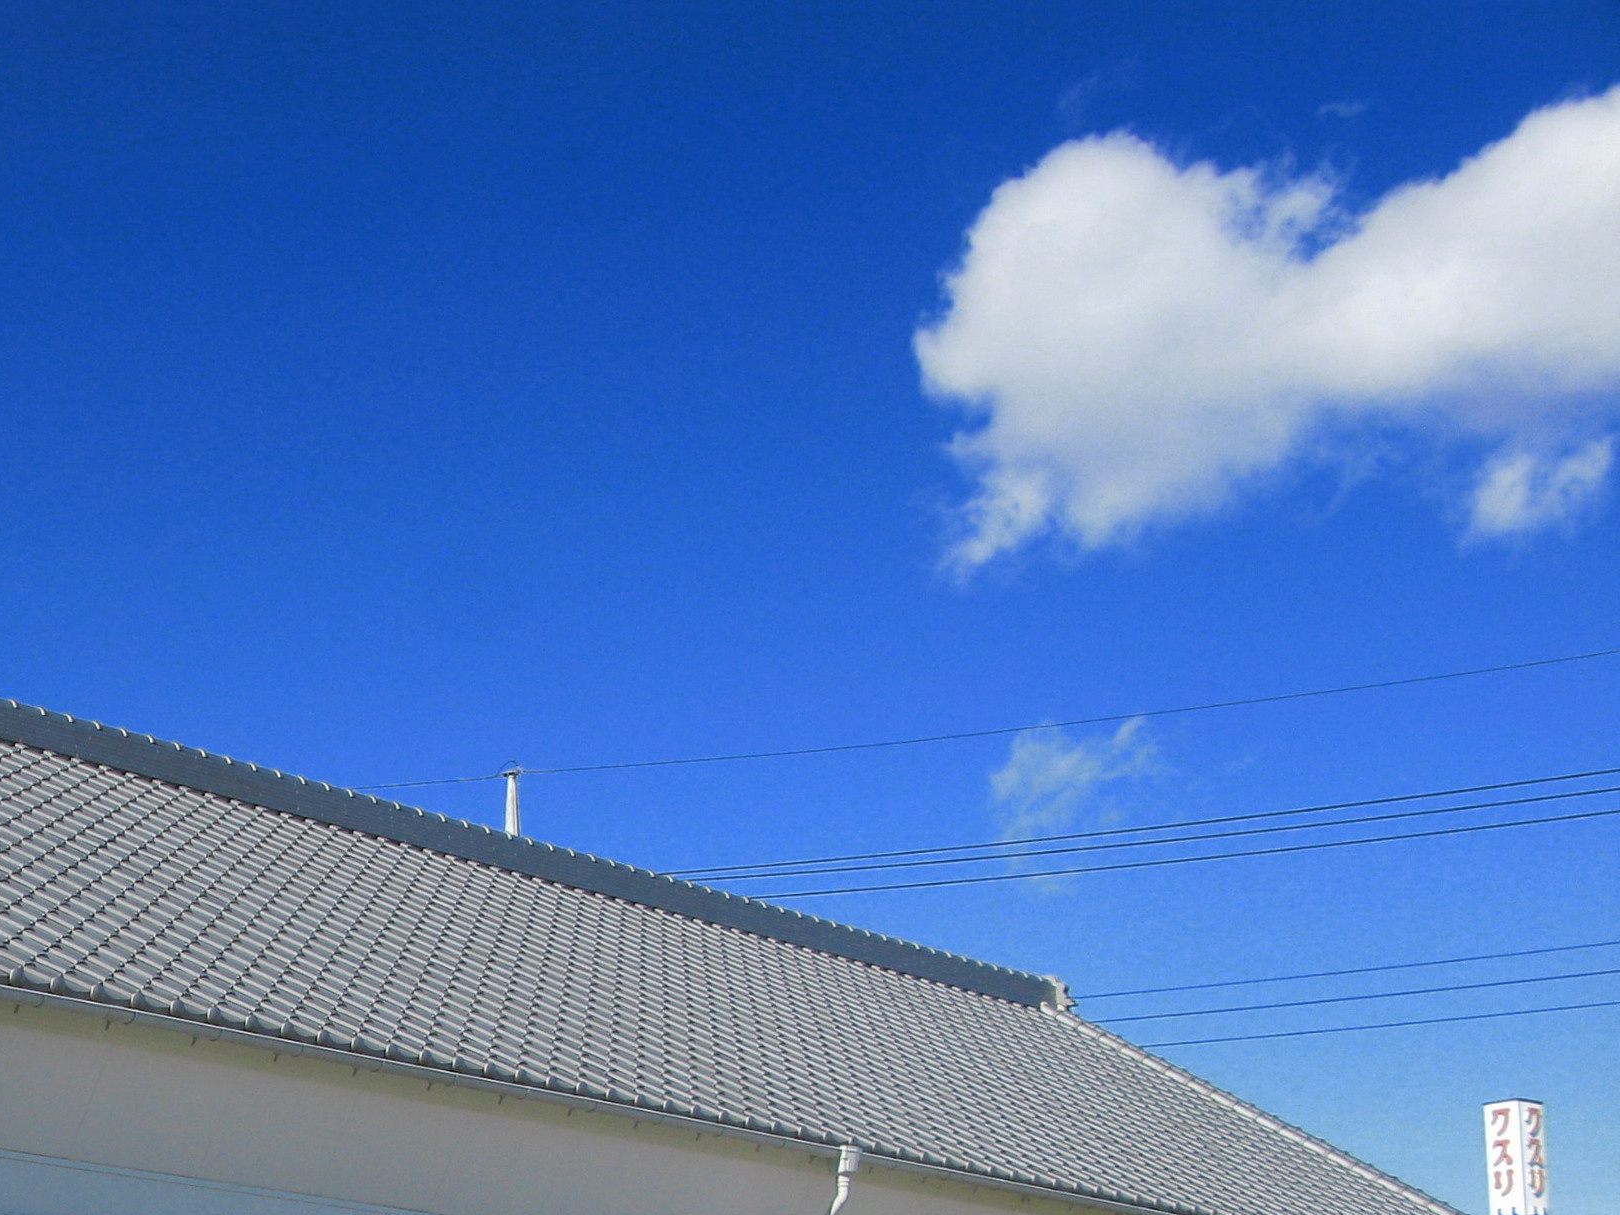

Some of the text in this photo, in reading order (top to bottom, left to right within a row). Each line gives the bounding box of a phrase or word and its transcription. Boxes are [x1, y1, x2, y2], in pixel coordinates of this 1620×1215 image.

[1491, 1108, 1515, 1197] クスリ
[1525, 1107, 1546, 1198] クスリ
